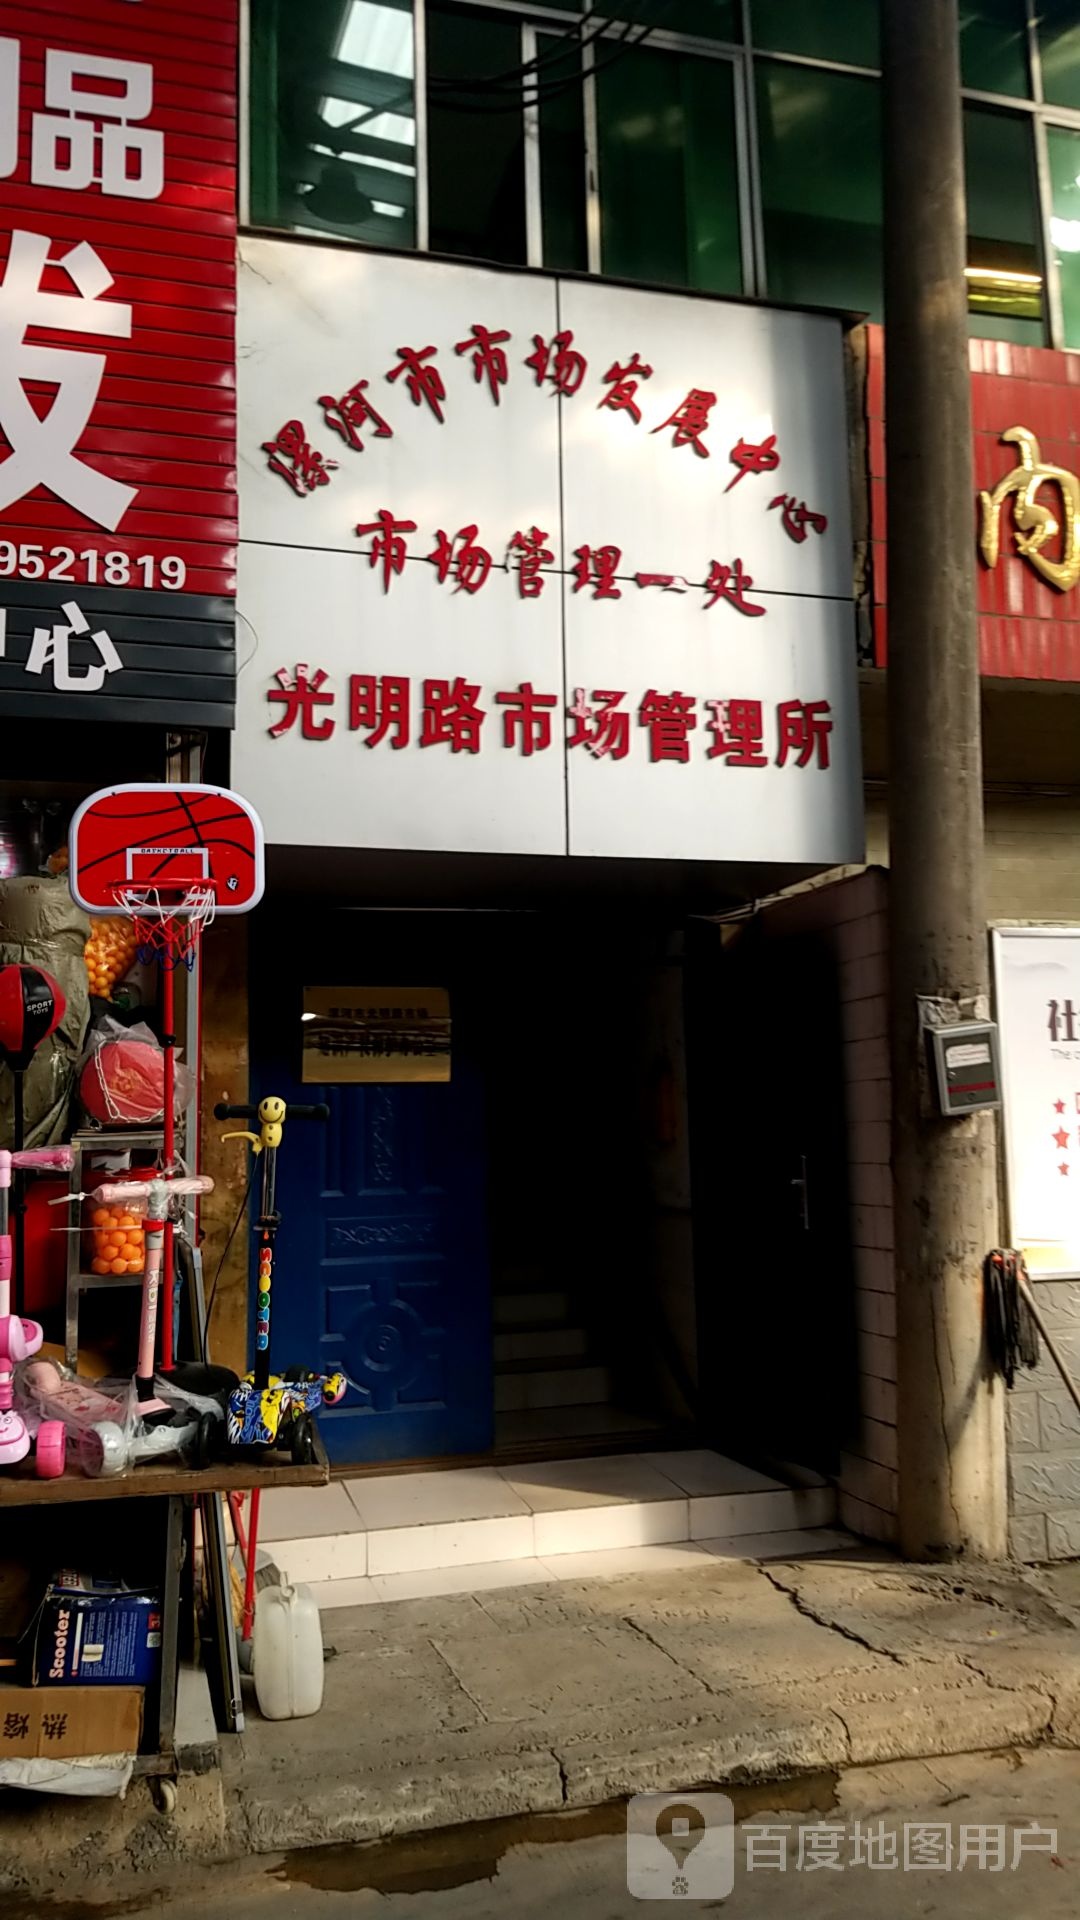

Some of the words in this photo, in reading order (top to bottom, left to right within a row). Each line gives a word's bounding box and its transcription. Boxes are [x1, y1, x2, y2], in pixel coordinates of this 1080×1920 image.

[0, 36, 165, 200] 品
[261, 324, 828, 543] 漯河市市场发展中心
[0, 540, 187, 590] 9521819
[355, 509, 766, 617] 市场管理一处
[0, 600, 124, 691] 心
[267, 668, 834, 769] 光明路市场管理所
[26, 999, 53, 1012] SPORT
[32, 1006, 49, 1016] TOYS
[48, 1609, 70, 1679] Scooter
[3, 1712, 69, 1739] 热熔
